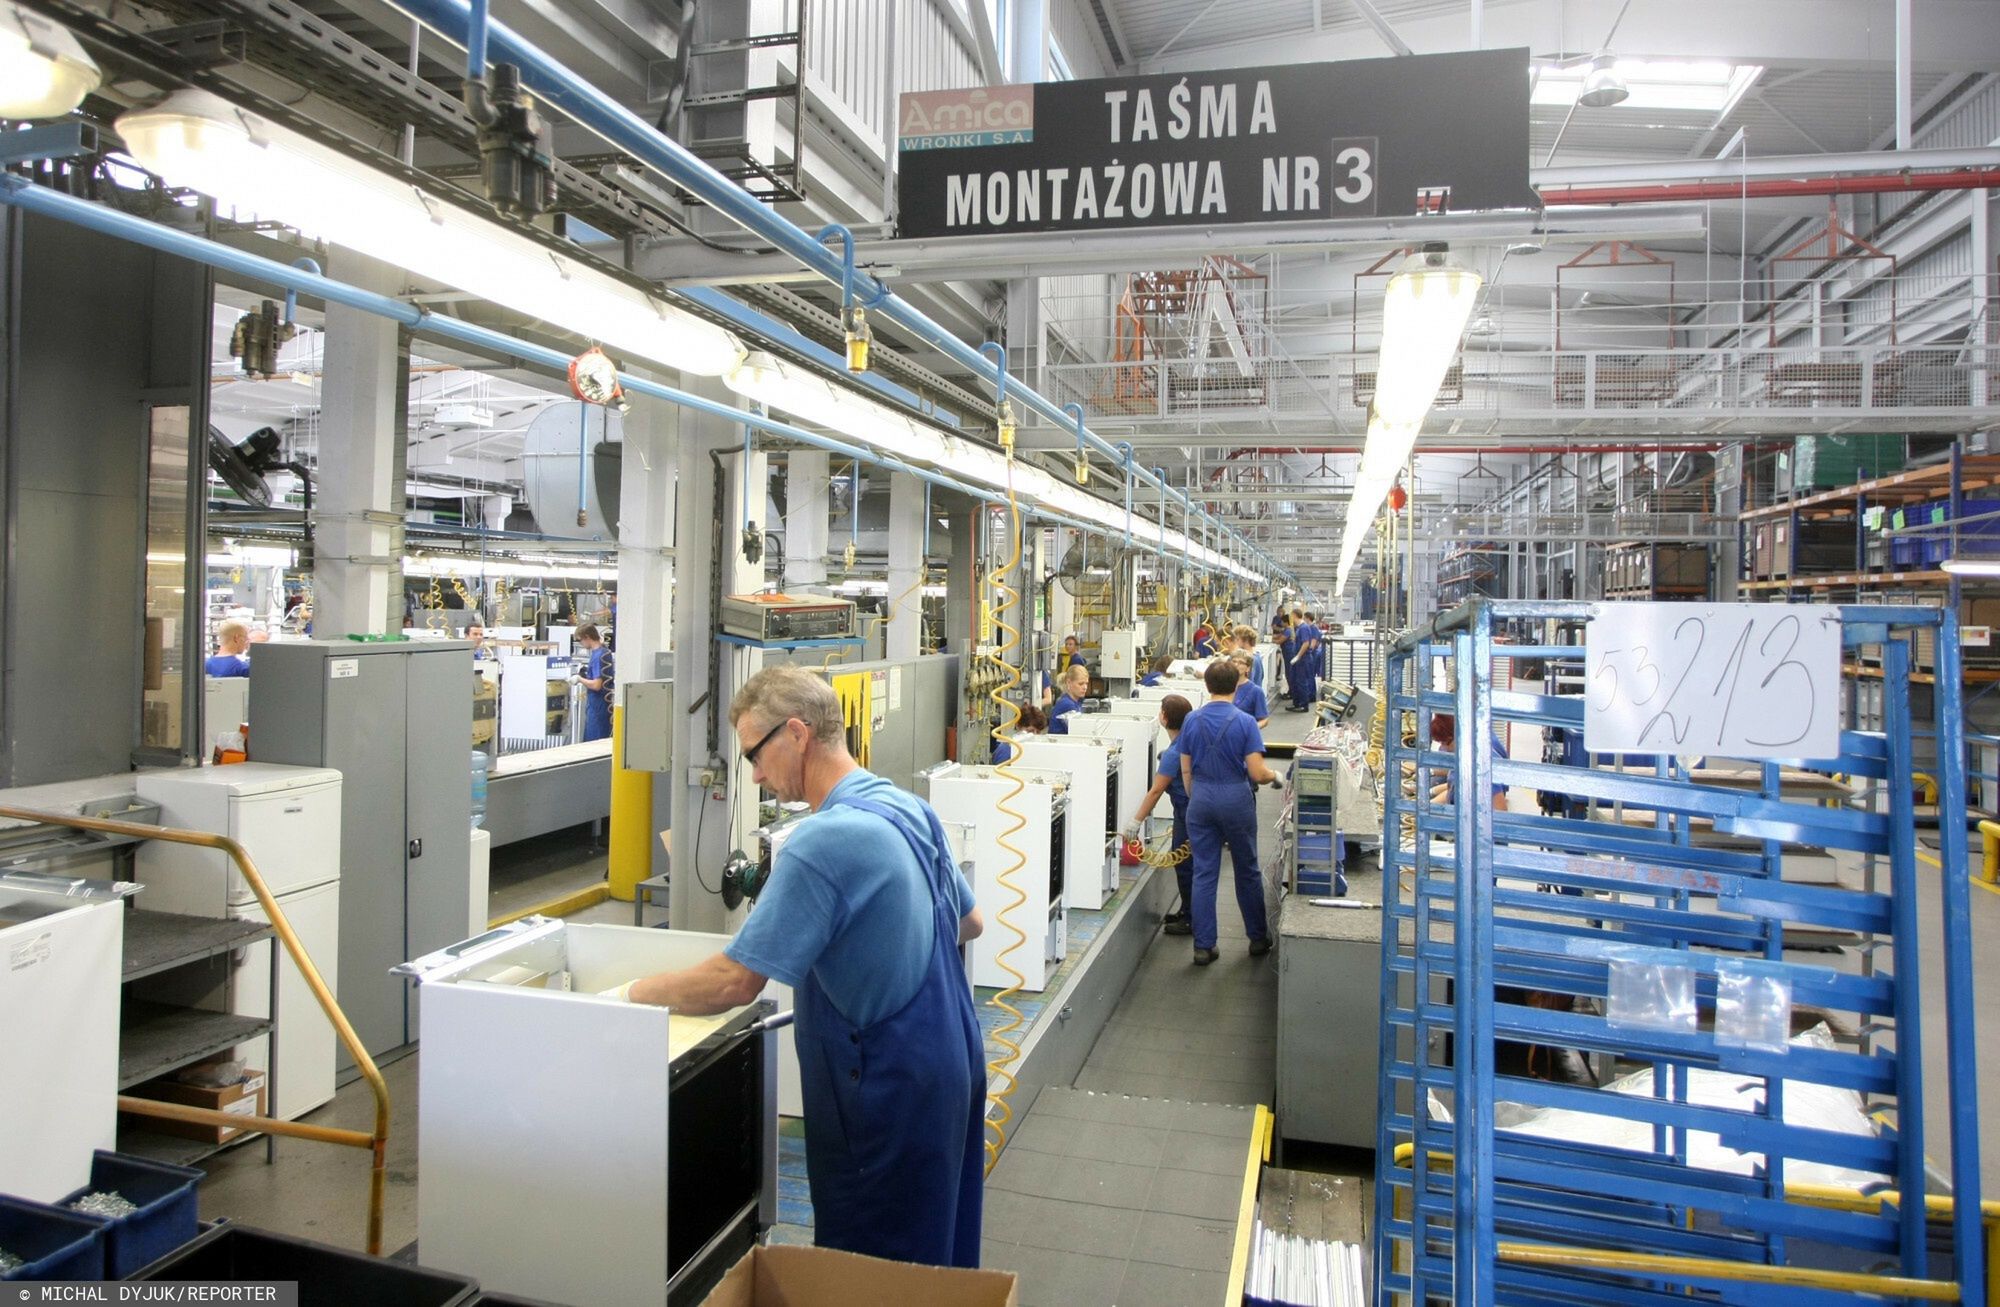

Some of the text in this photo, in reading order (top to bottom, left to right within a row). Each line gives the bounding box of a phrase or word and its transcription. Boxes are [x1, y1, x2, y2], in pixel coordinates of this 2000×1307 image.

[903, 90, 1030, 132] Amica
[1105, 77, 1276, 143] TAŚMA
[904, 132, 1031, 149] WRONKI S.A.
[946, 147, 1373, 227] MONTAŻOWA NR 3
